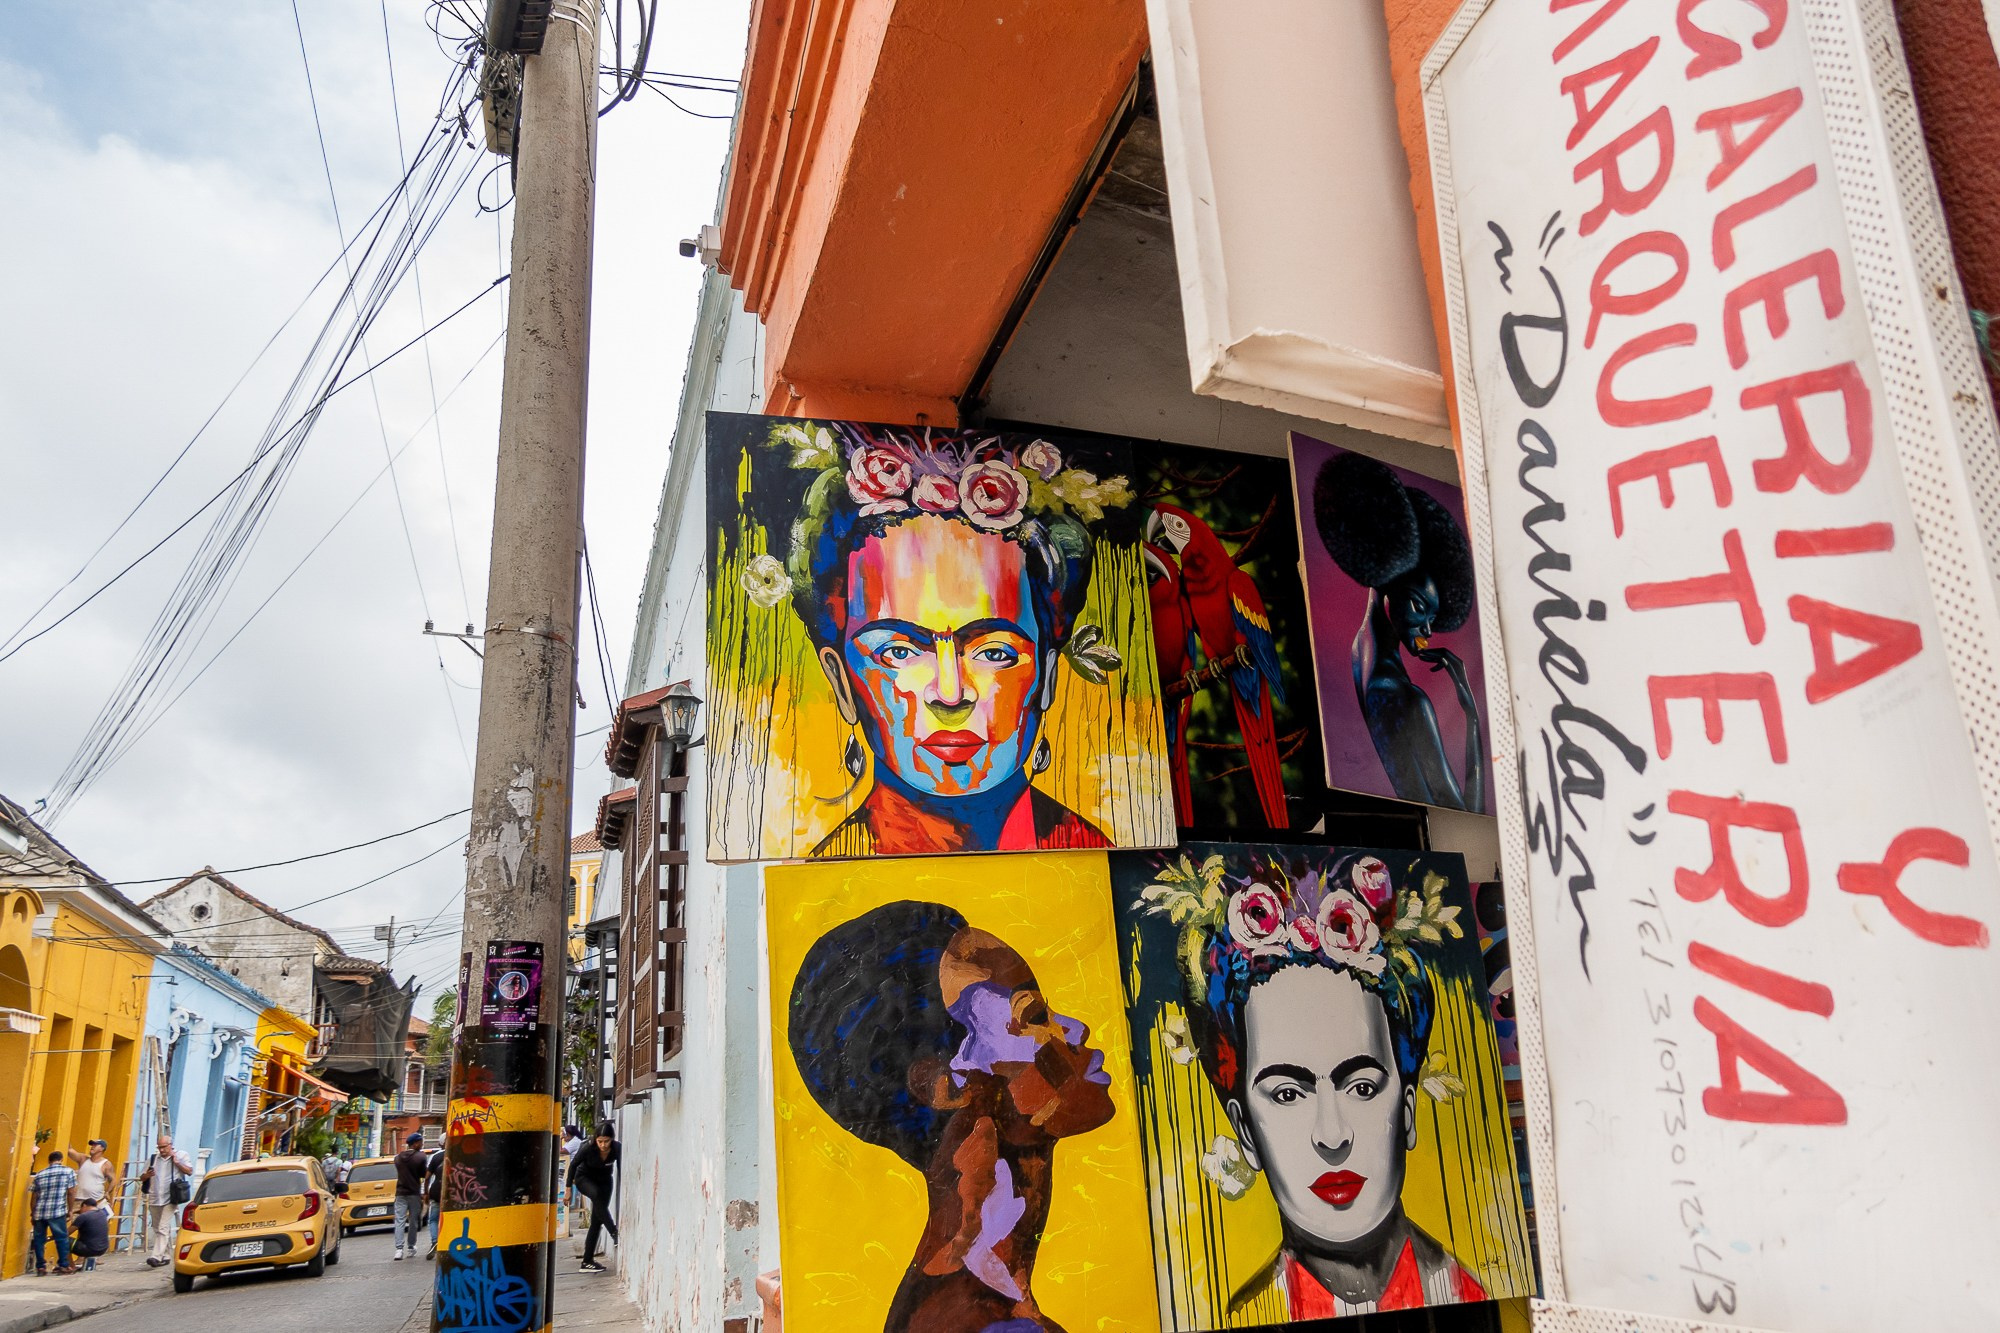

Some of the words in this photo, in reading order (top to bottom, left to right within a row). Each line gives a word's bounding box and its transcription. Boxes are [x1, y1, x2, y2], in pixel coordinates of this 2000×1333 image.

[1675, 0, 1923, 705] GALERIA
[1836, 826, 1990, 950] Y
[223, 1222, 251, 1231] SERVICIO
